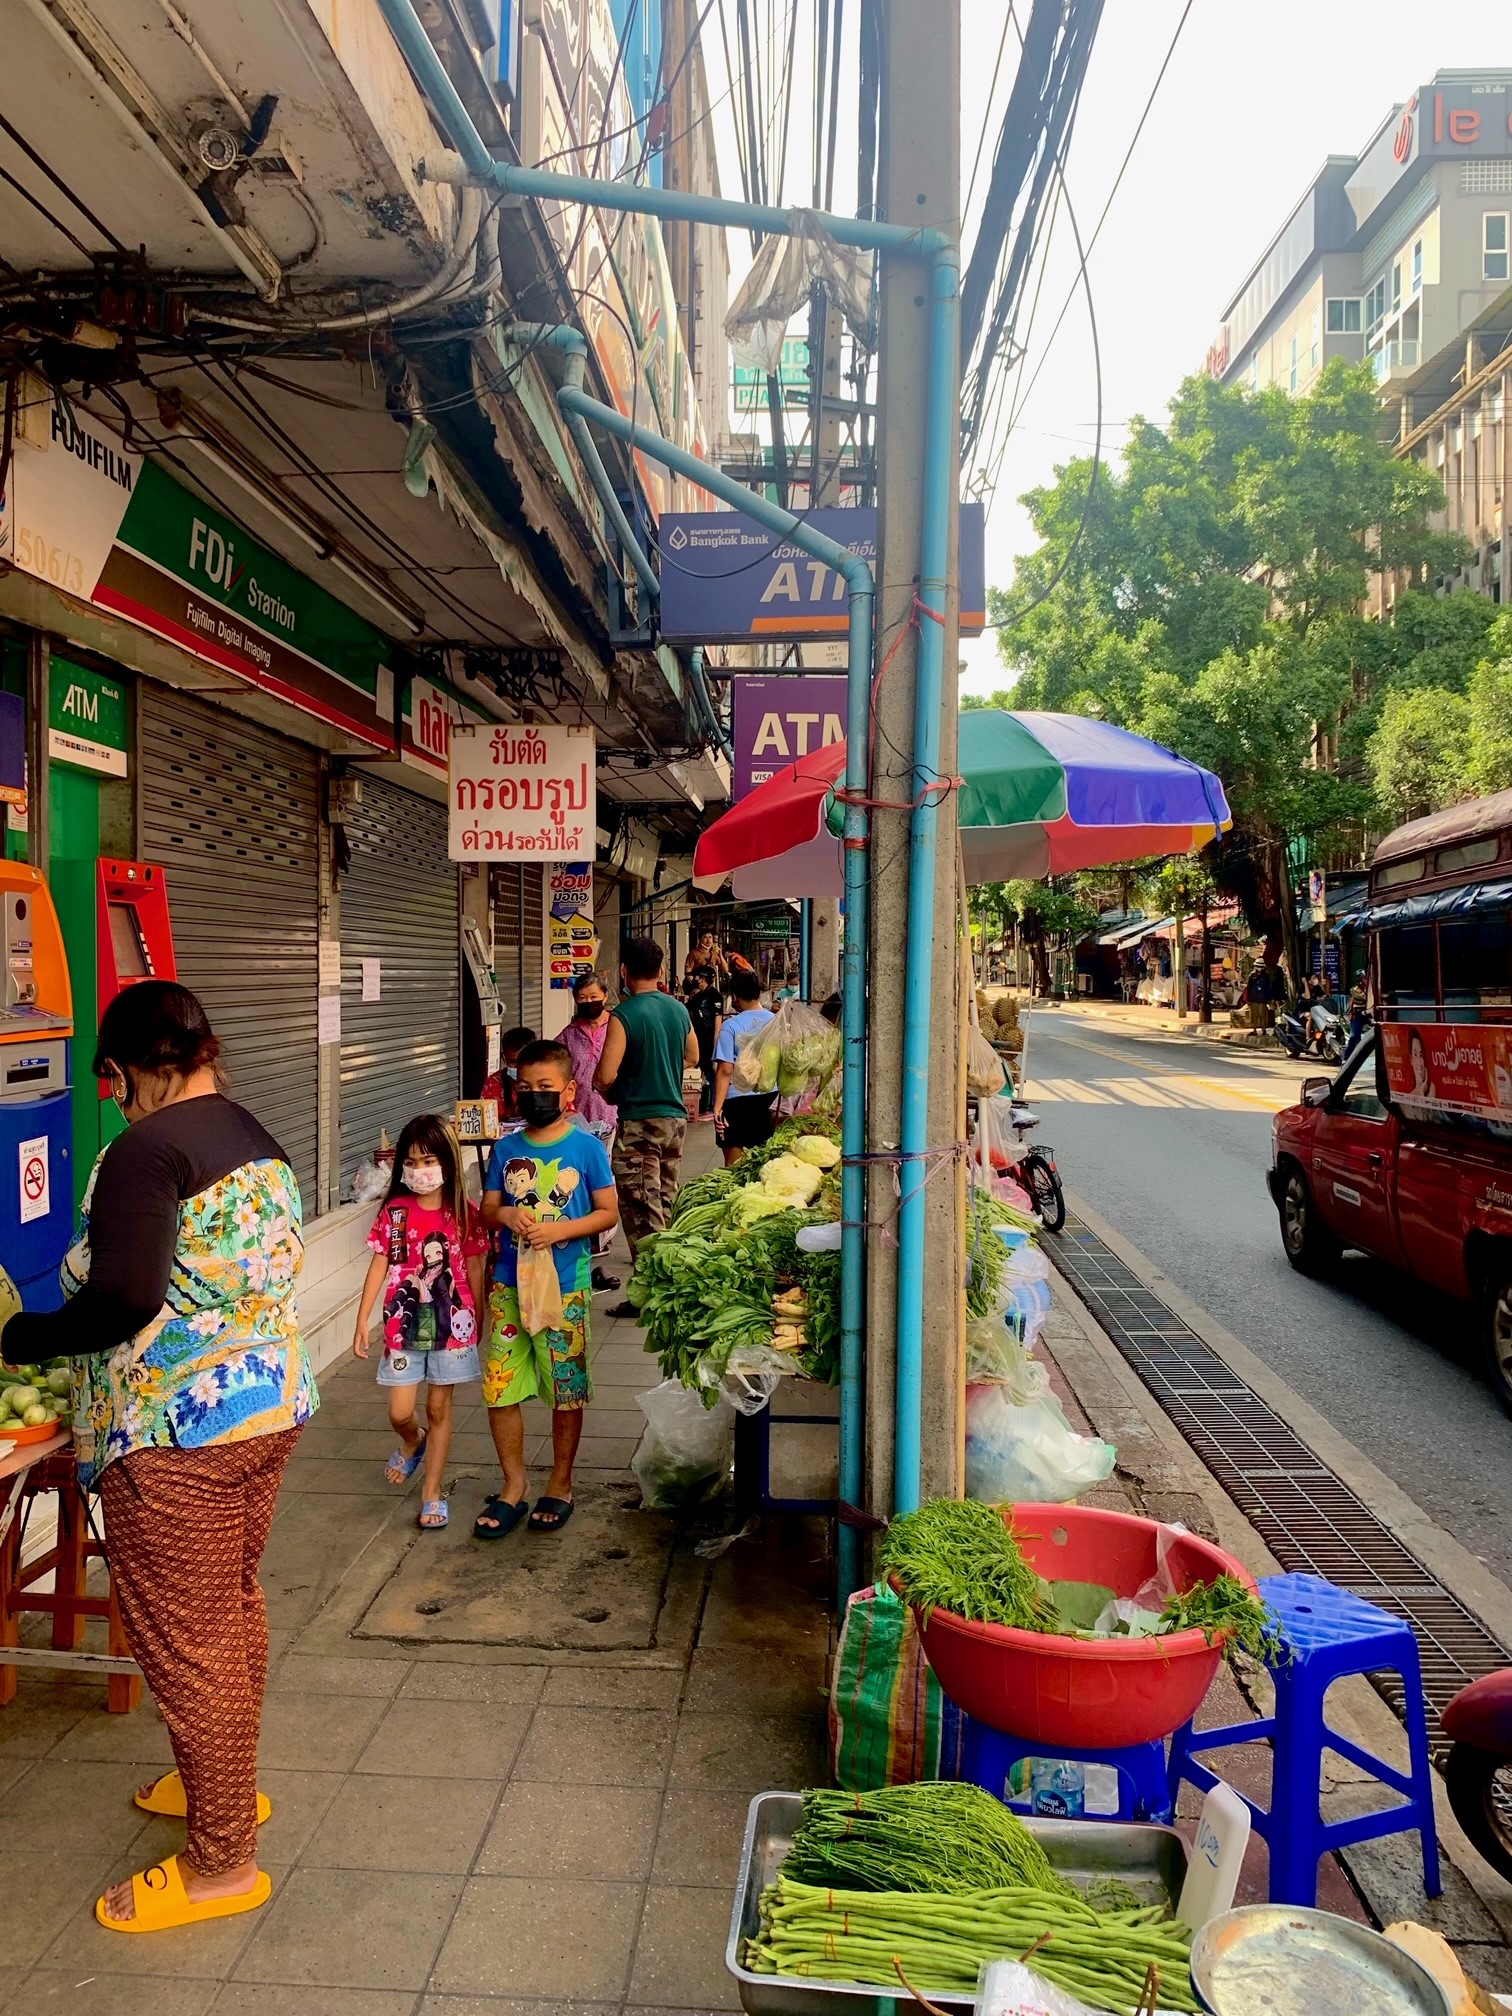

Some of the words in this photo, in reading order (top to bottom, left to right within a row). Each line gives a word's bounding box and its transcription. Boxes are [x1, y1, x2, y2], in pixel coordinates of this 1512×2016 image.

[52, 409, 132, 493] FUJIFILM
[18, 527, 84, 592] 506/3
[690, 536, 738, 548] Bangkok
[741, 534, 769, 545] Bank
[187, 602, 216, 634] Fujifilm
[218, 620, 243, 646] Digital
[244, 635, 271, 667] Imaging
[62, 684, 98, 723] ATM
[489, 729, 547, 765] รับตัด
[457, 763, 588, 826] กรอบรูป
